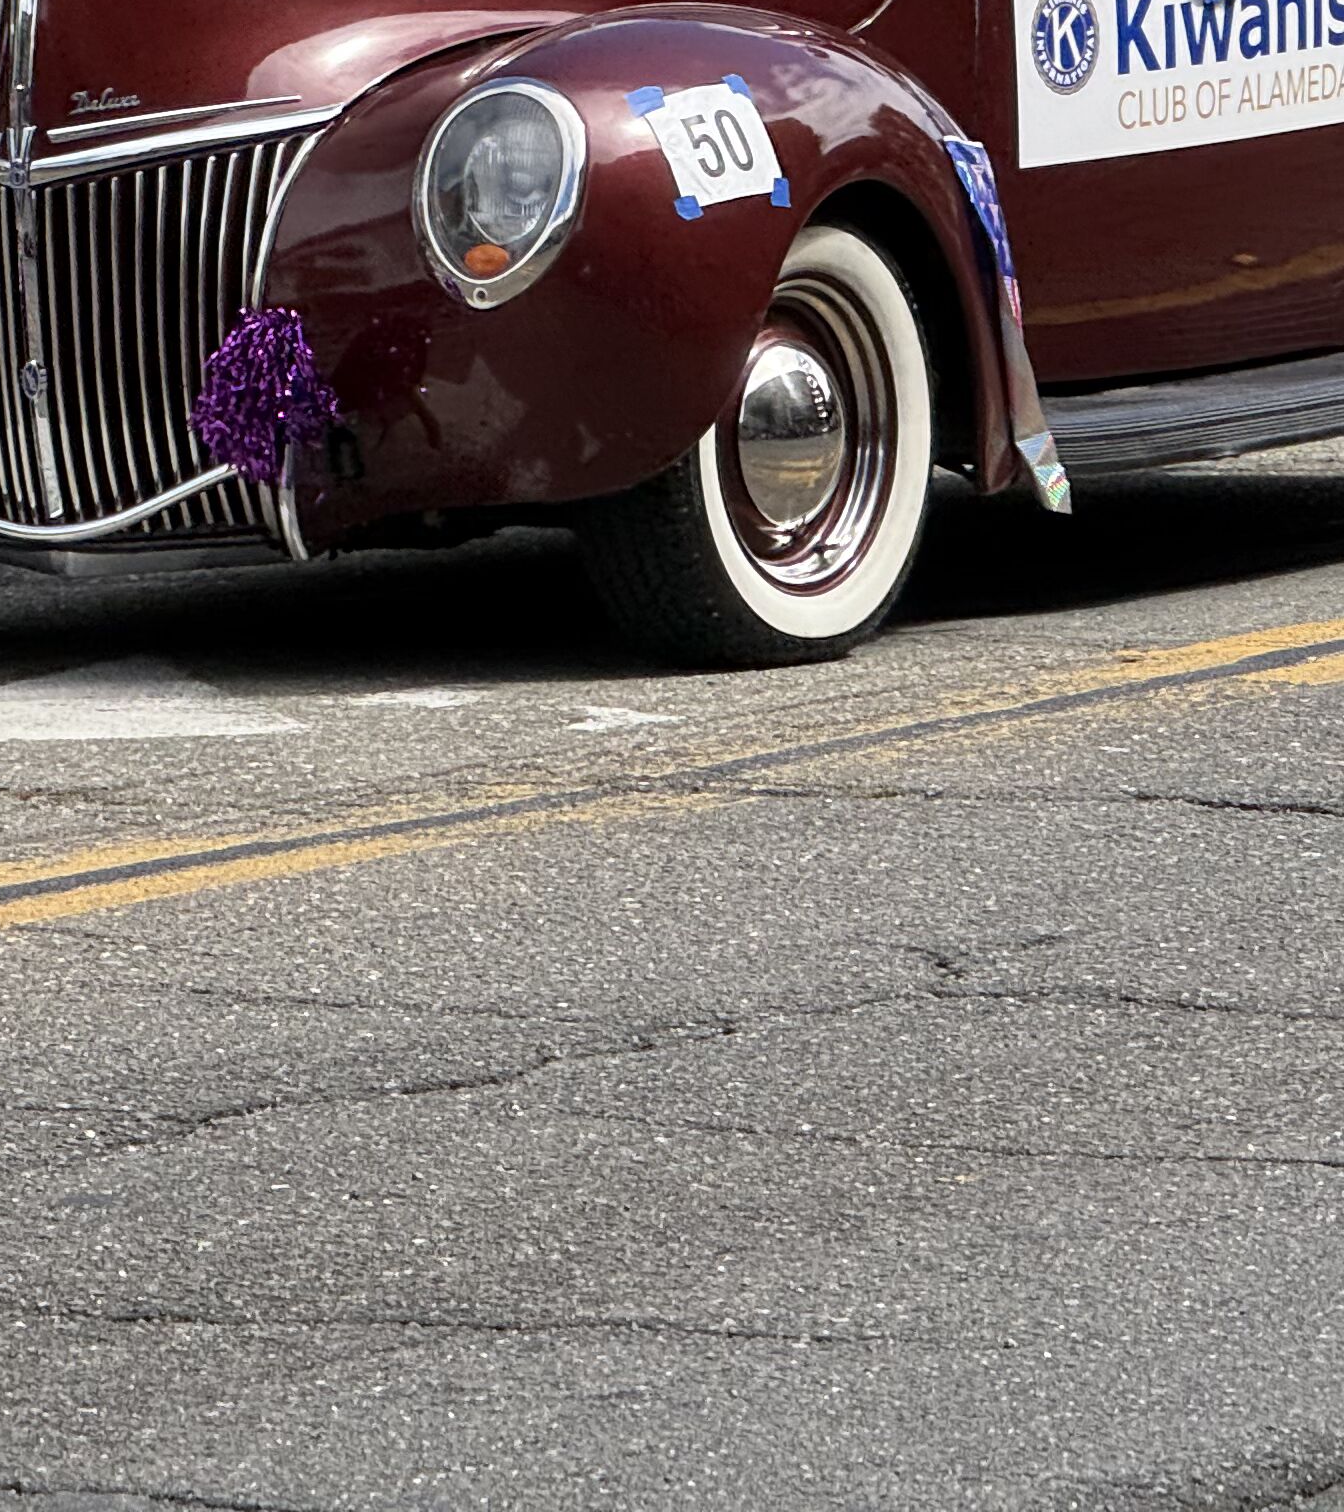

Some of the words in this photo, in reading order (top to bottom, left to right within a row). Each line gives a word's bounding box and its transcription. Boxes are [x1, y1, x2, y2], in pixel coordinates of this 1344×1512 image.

[1036, 25, 1095, 86] INTERNATIONAL
[1051, 6, 1083, 71] K
[1117, 85, 1187, 130] CLUB
[1195, 77, 1232, 119] OF
[680, 109, 754, 178] 50
